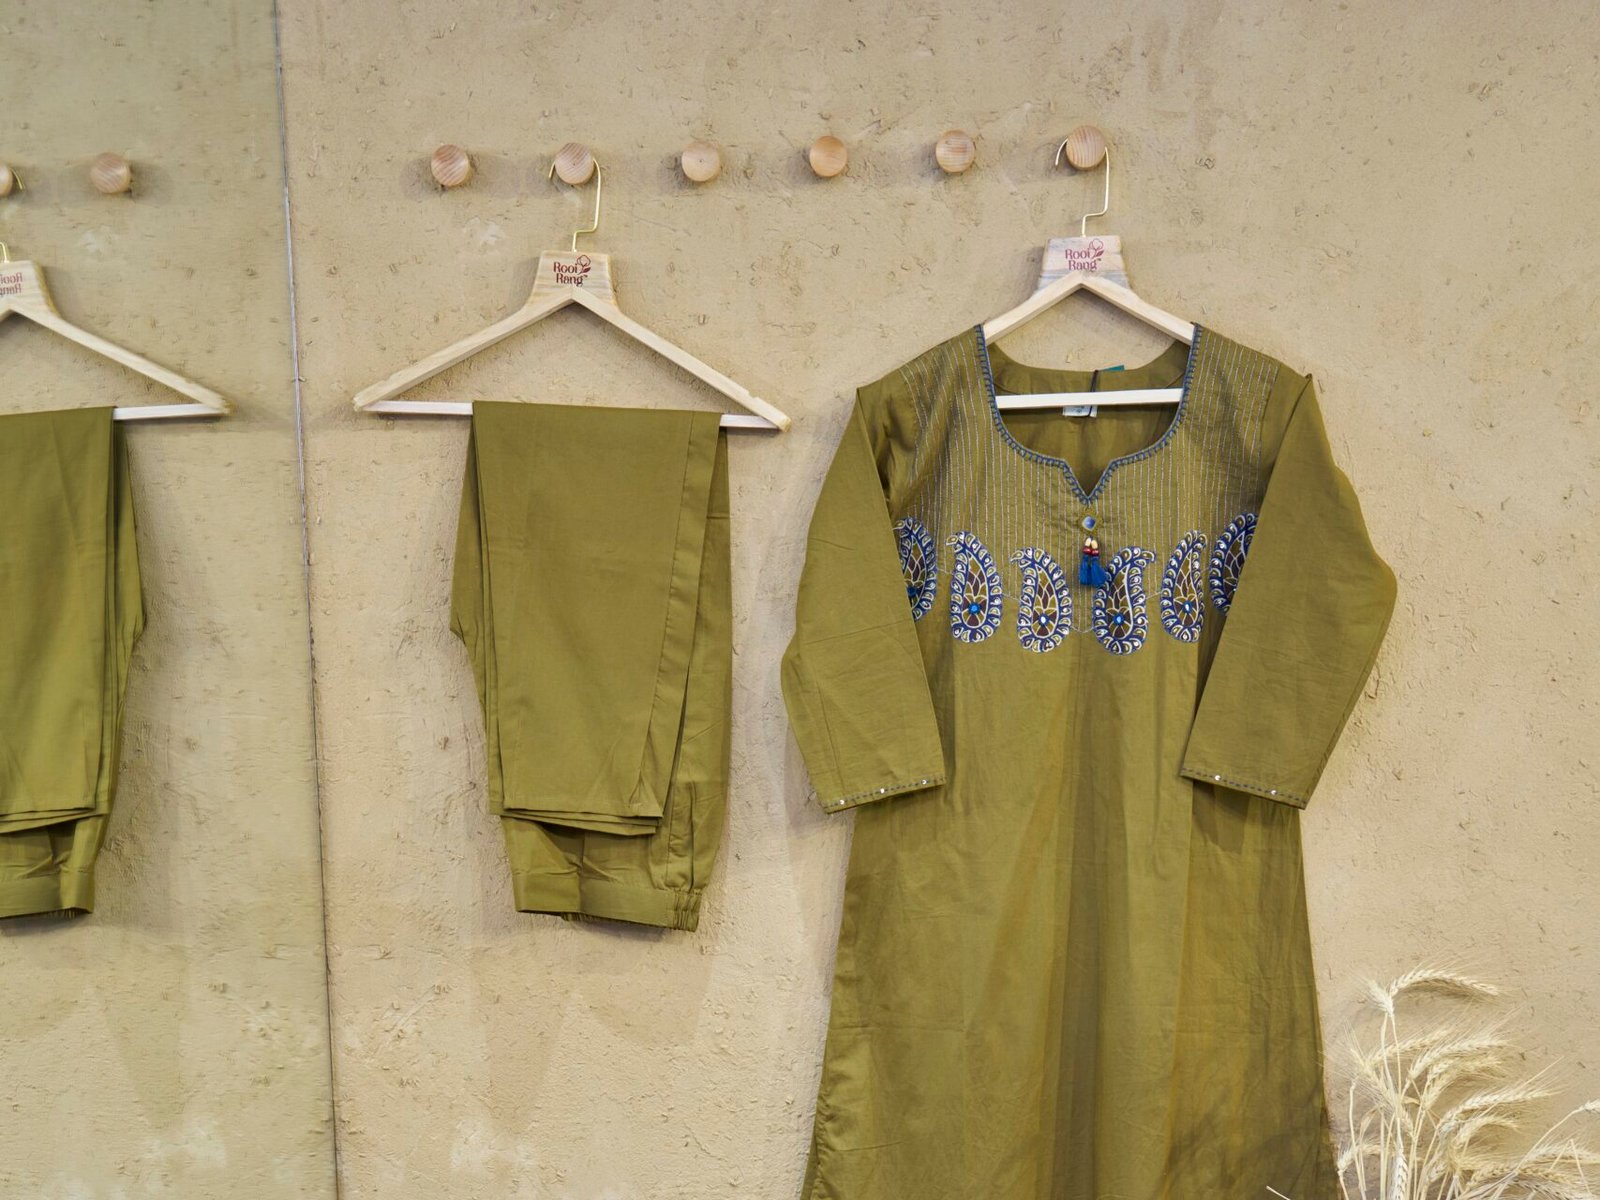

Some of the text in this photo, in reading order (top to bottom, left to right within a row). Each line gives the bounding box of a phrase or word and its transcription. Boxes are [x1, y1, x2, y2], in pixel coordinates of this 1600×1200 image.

[1065, 248, 1090, 260] Rooi
[553, 261, 578, 273] Rooi
[1068, 260, 1097, 272] Rang
[556, 273, 583, 287] Rang
